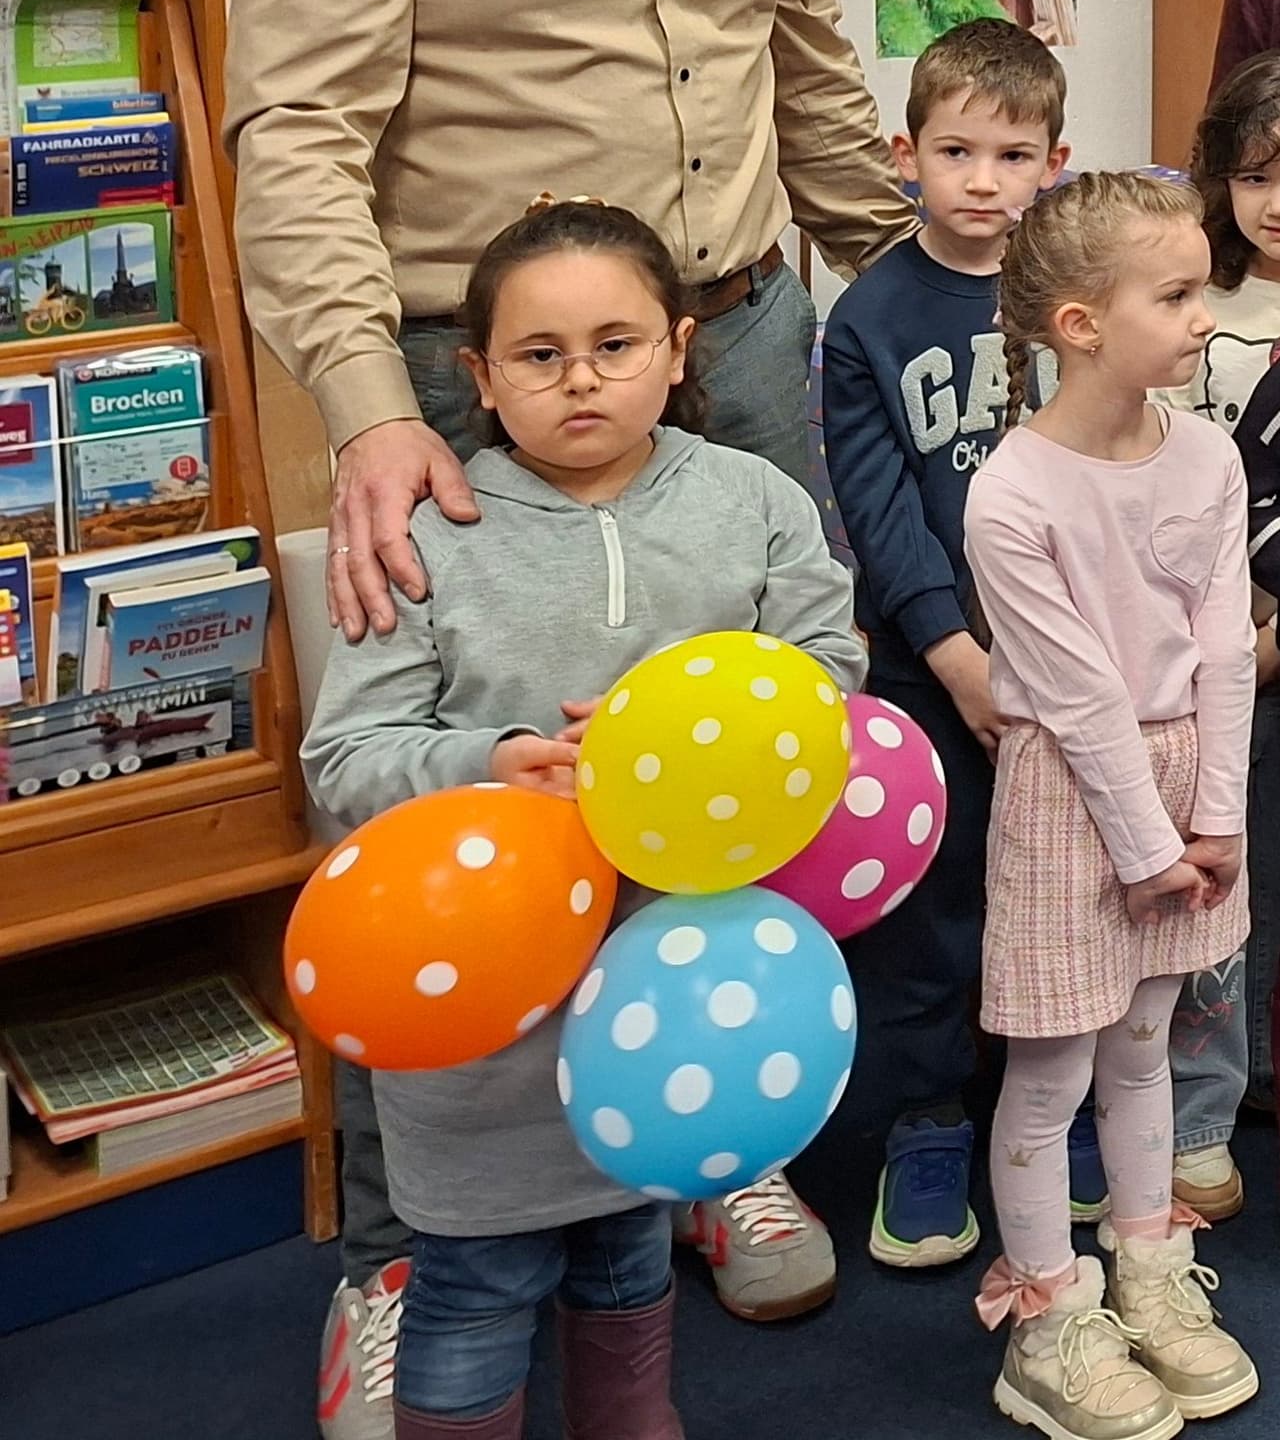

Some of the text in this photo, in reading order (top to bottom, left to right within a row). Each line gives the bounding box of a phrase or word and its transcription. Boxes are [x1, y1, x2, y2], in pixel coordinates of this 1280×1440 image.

[23, 132, 141, 154] FAHRRADKARTE
[77, 160, 160, 178] SCHWEIZ
[90, 388, 184, 414] Brocken
[128, 615, 254, 657] PADDELN
